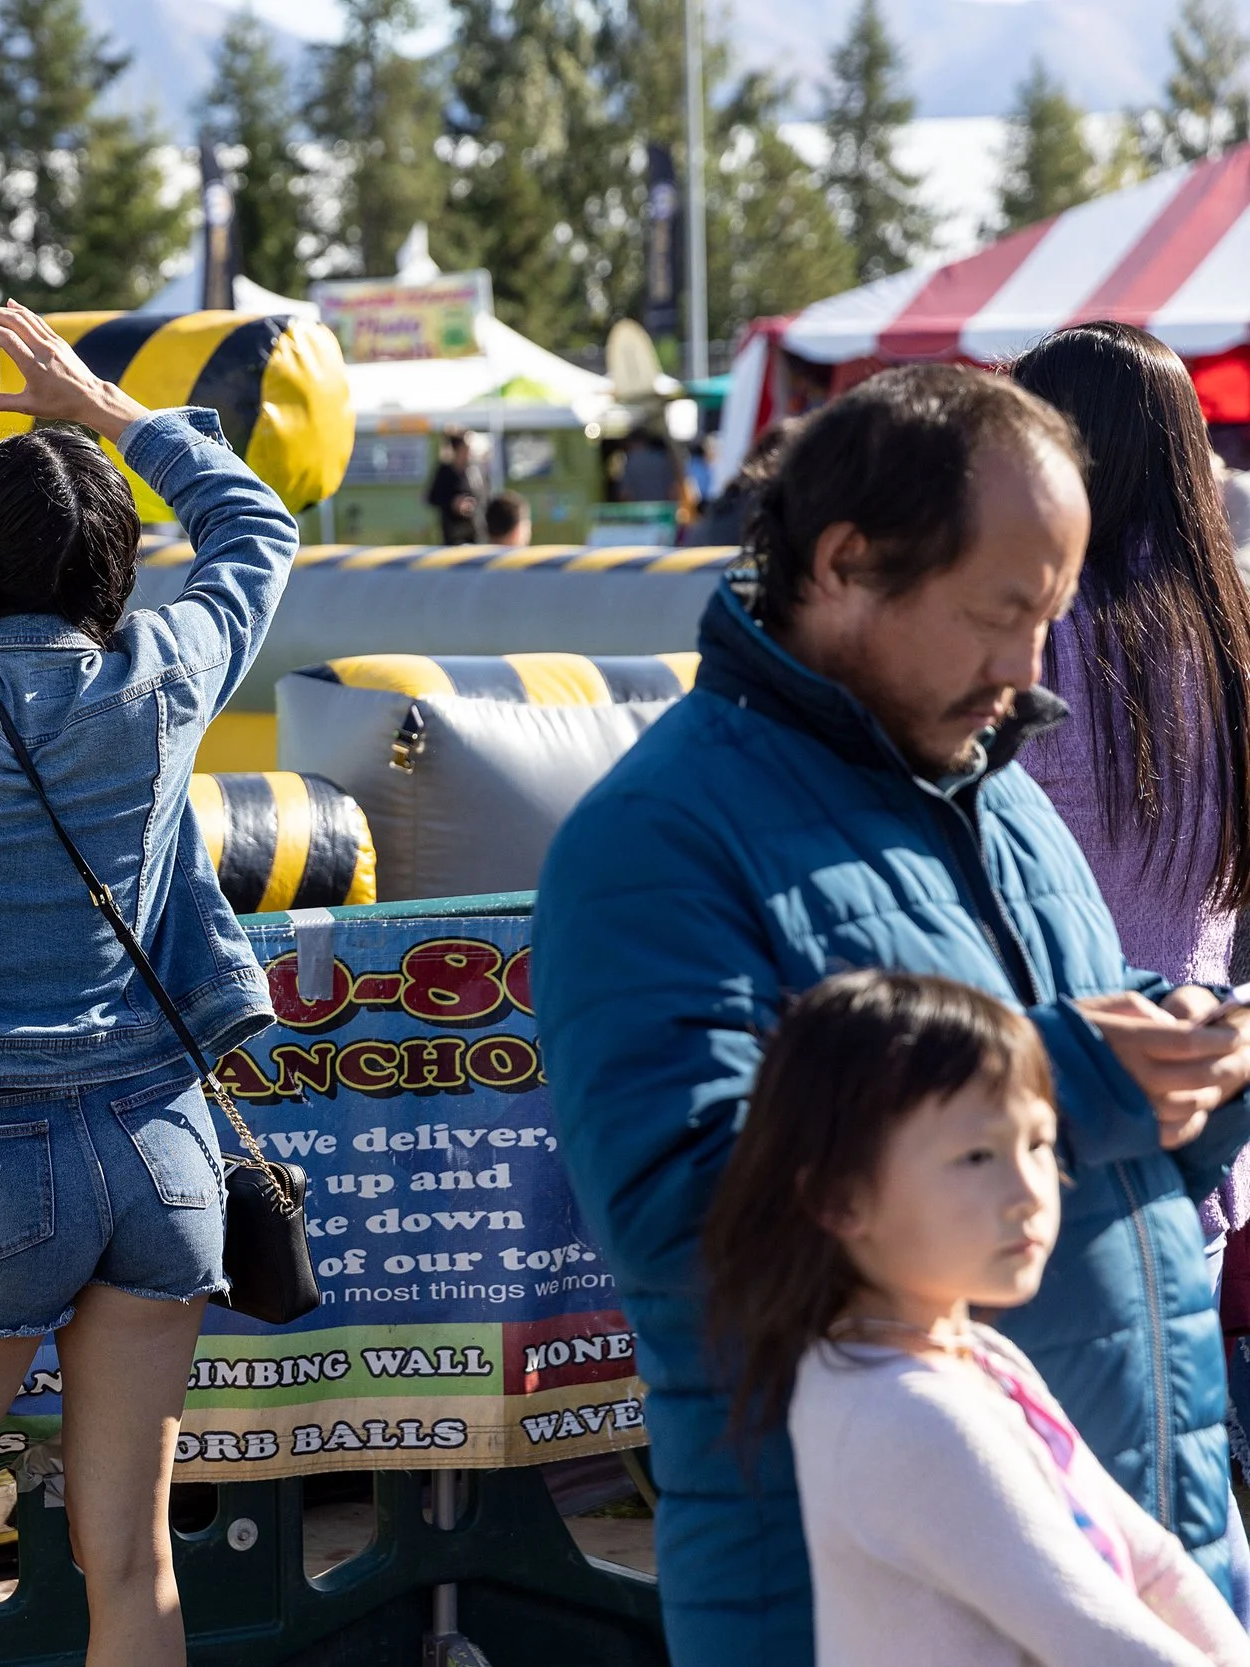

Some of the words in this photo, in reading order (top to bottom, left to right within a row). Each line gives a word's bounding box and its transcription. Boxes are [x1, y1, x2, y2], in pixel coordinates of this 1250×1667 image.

[203, 1035, 548, 1097] ANCHO
[352, 1123, 558, 1152] deliver,
[325, 1173, 395, 1199] up
[409, 1162, 512, 1192] and
[365, 1208, 525, 1234] down
[318, 1248, 367, 1277] of
[383, 1251, 483, 1275] our
[498, 1242, 596, 1272] toys.
[345, 1283, 421, 1302] most
[429, 1281, 526, 1303] things
[534, 1279, 560, 1297] we
[363, 1348, 492, 1377] WALL
[524, 1332, 639, 1372] MONE
[294, 1420, 467, 1454] BALLS
